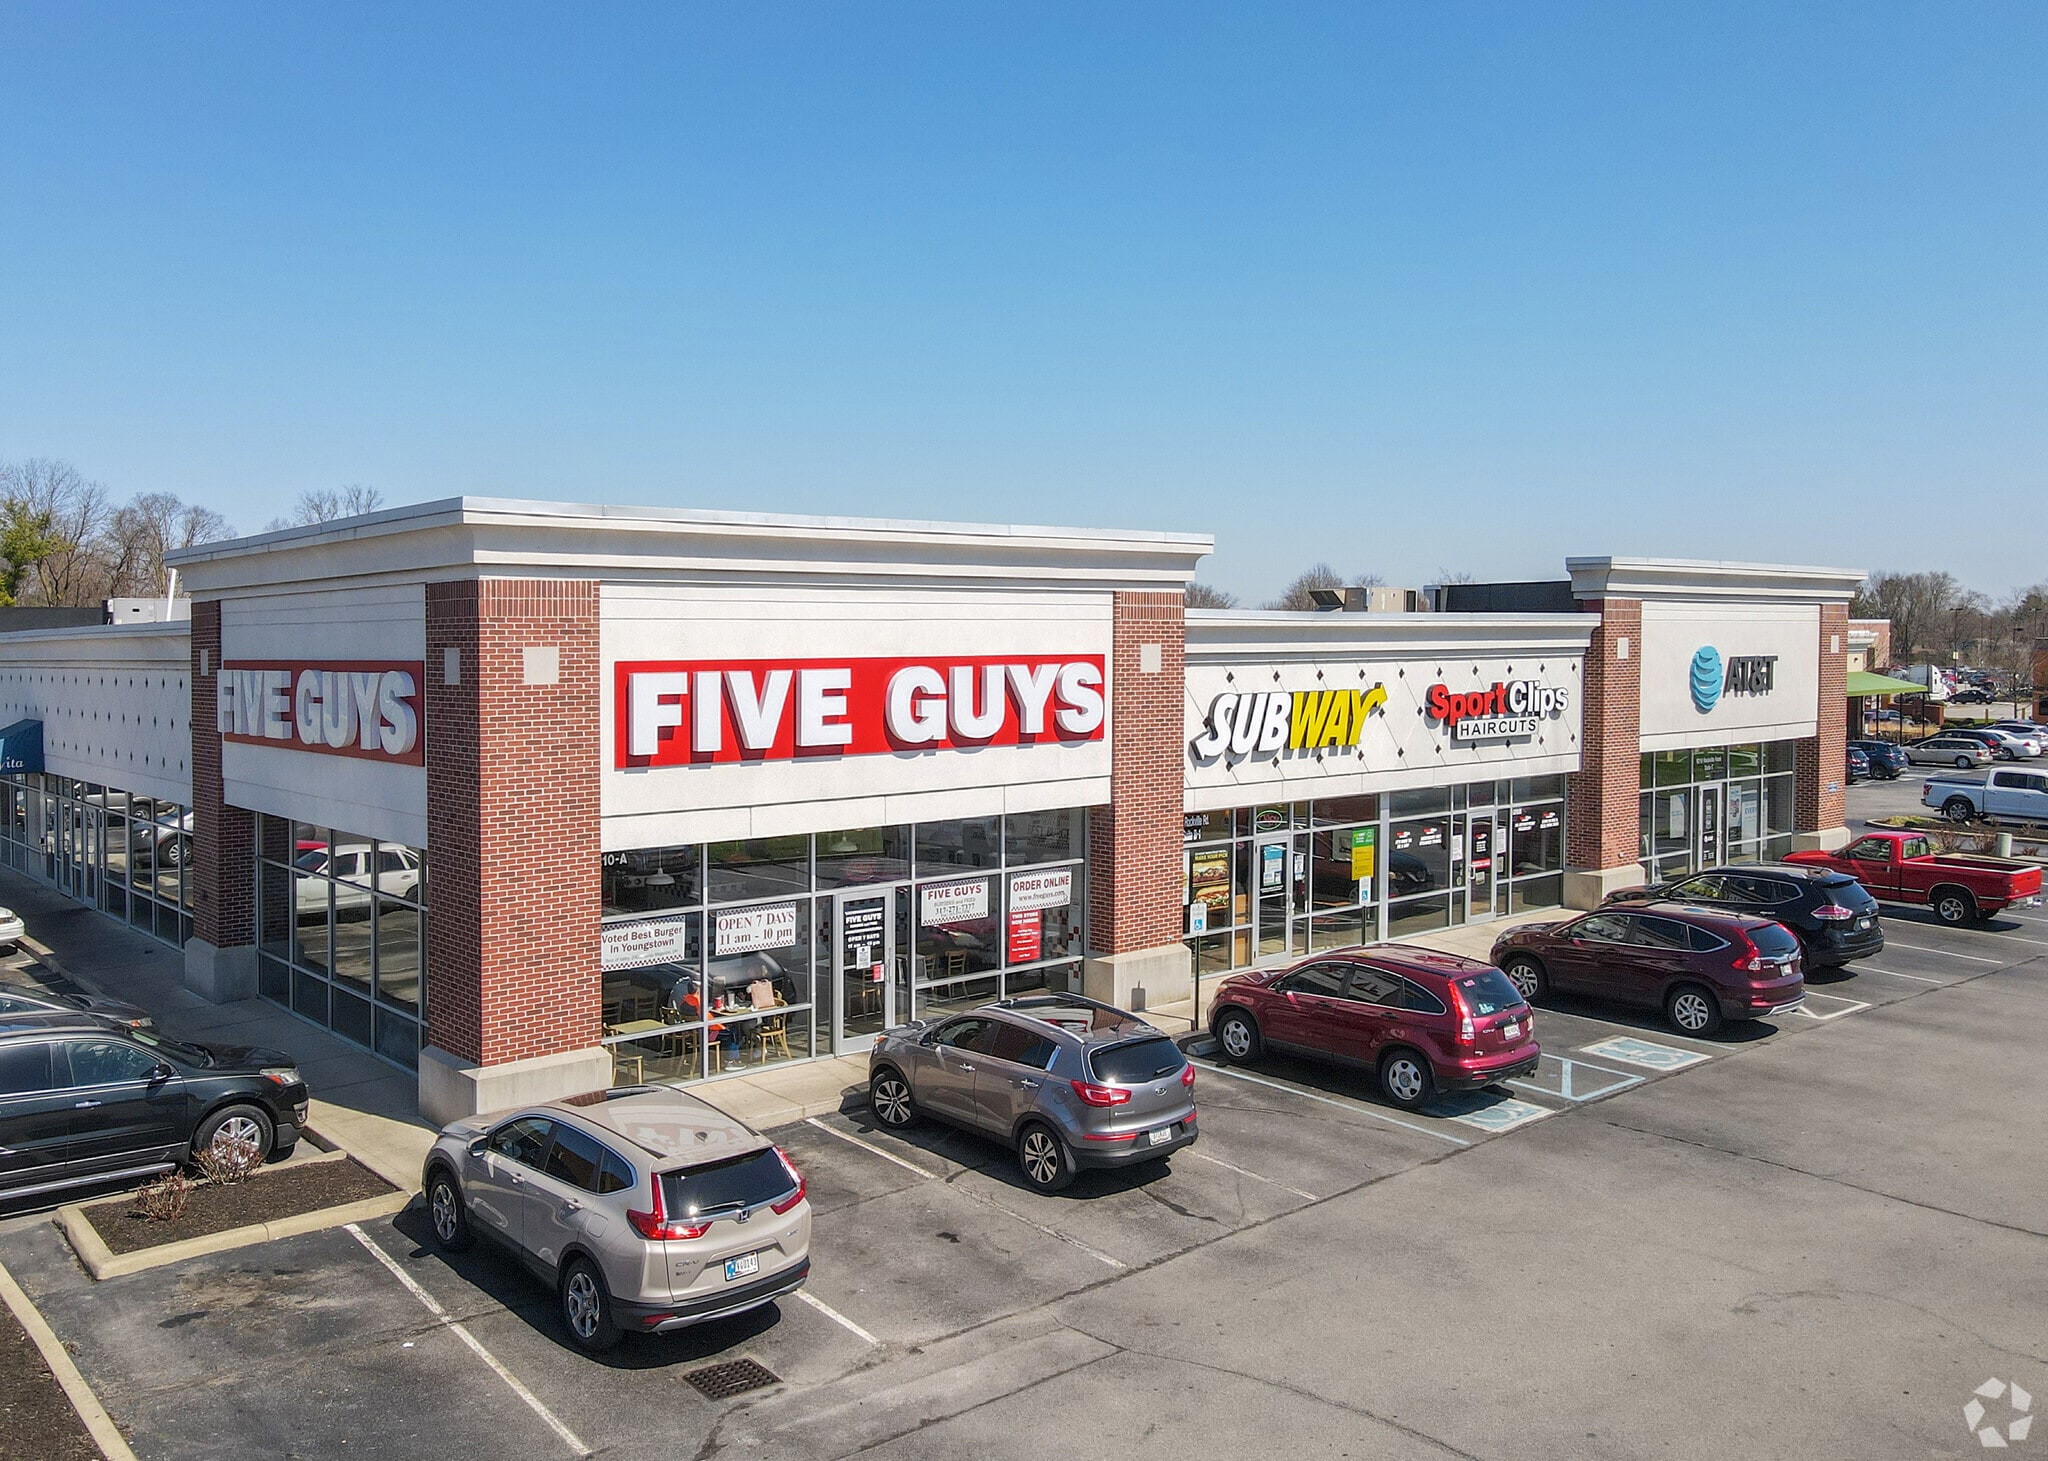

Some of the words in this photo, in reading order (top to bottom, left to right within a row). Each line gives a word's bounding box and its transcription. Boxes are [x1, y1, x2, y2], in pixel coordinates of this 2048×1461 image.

[1723, 655, 1778, 695] AT&T
[217, 669, 293, 740] FIVE
[296, 669, 417, 755] GUYS
[628, 668, 853, 756] FIVE
[884, 662, 1105, 744] GUYS
[1428, 683, 1507, 727] Sport
[1507, 680, 1569, 718] Clips
[1193, 683, 1388, 761] SUBWAY
[1460, 719, 1537, 737] HAIRCUTS
[927, 888, 951, 900] FIVE
[954, 884, 982, 896] GUYS
[1013, 879, 1042, 892] ORDER
[1043, 875, 1070, 889] ONLINE
[718, 916, 752, 931] OPEN
[756, 914, 762, 927] 7
[766, 911, 795, 925] DAYS
[845, 915, 862, 924] FIVE
[862, 912, 882, 922] GUYS
[601, 932, 629, 944] Voted
[631, 930, 652, 941] Best
[654, 926, 683, 938] Burger
[720, 933, 730, 945] 11
[734, 934, 751, 944] am
[763, 928, 773, 940] 10
[776, 928, 792, 940] pm
[610, 944, 618, 953] In
[621, 938, 674, 953] Youngstown
